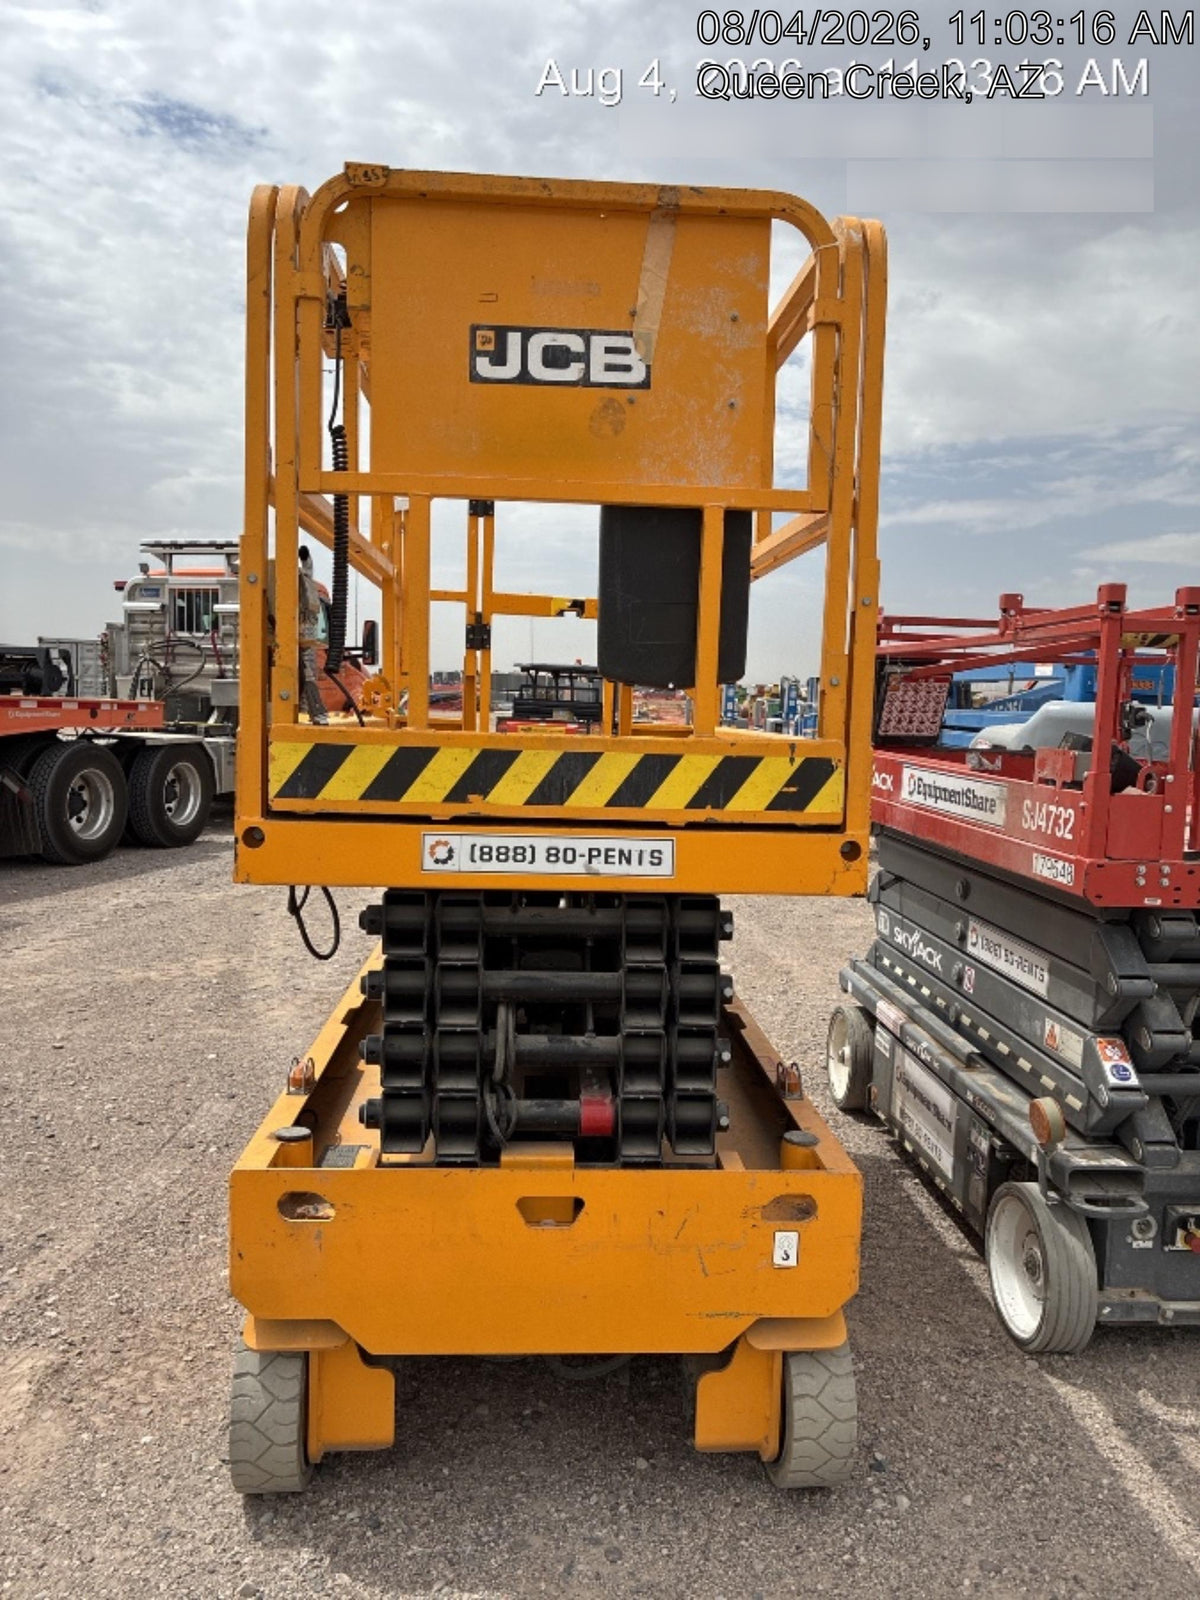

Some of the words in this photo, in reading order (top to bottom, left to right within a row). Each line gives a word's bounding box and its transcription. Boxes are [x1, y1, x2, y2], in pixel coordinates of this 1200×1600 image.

[475, 332, 647, 383] JCB
[917, 777, 997, 814] EquipmentShare
[1022, 799, 1075, 840] SJ4732
[470, 844, 536, 865] (888)
